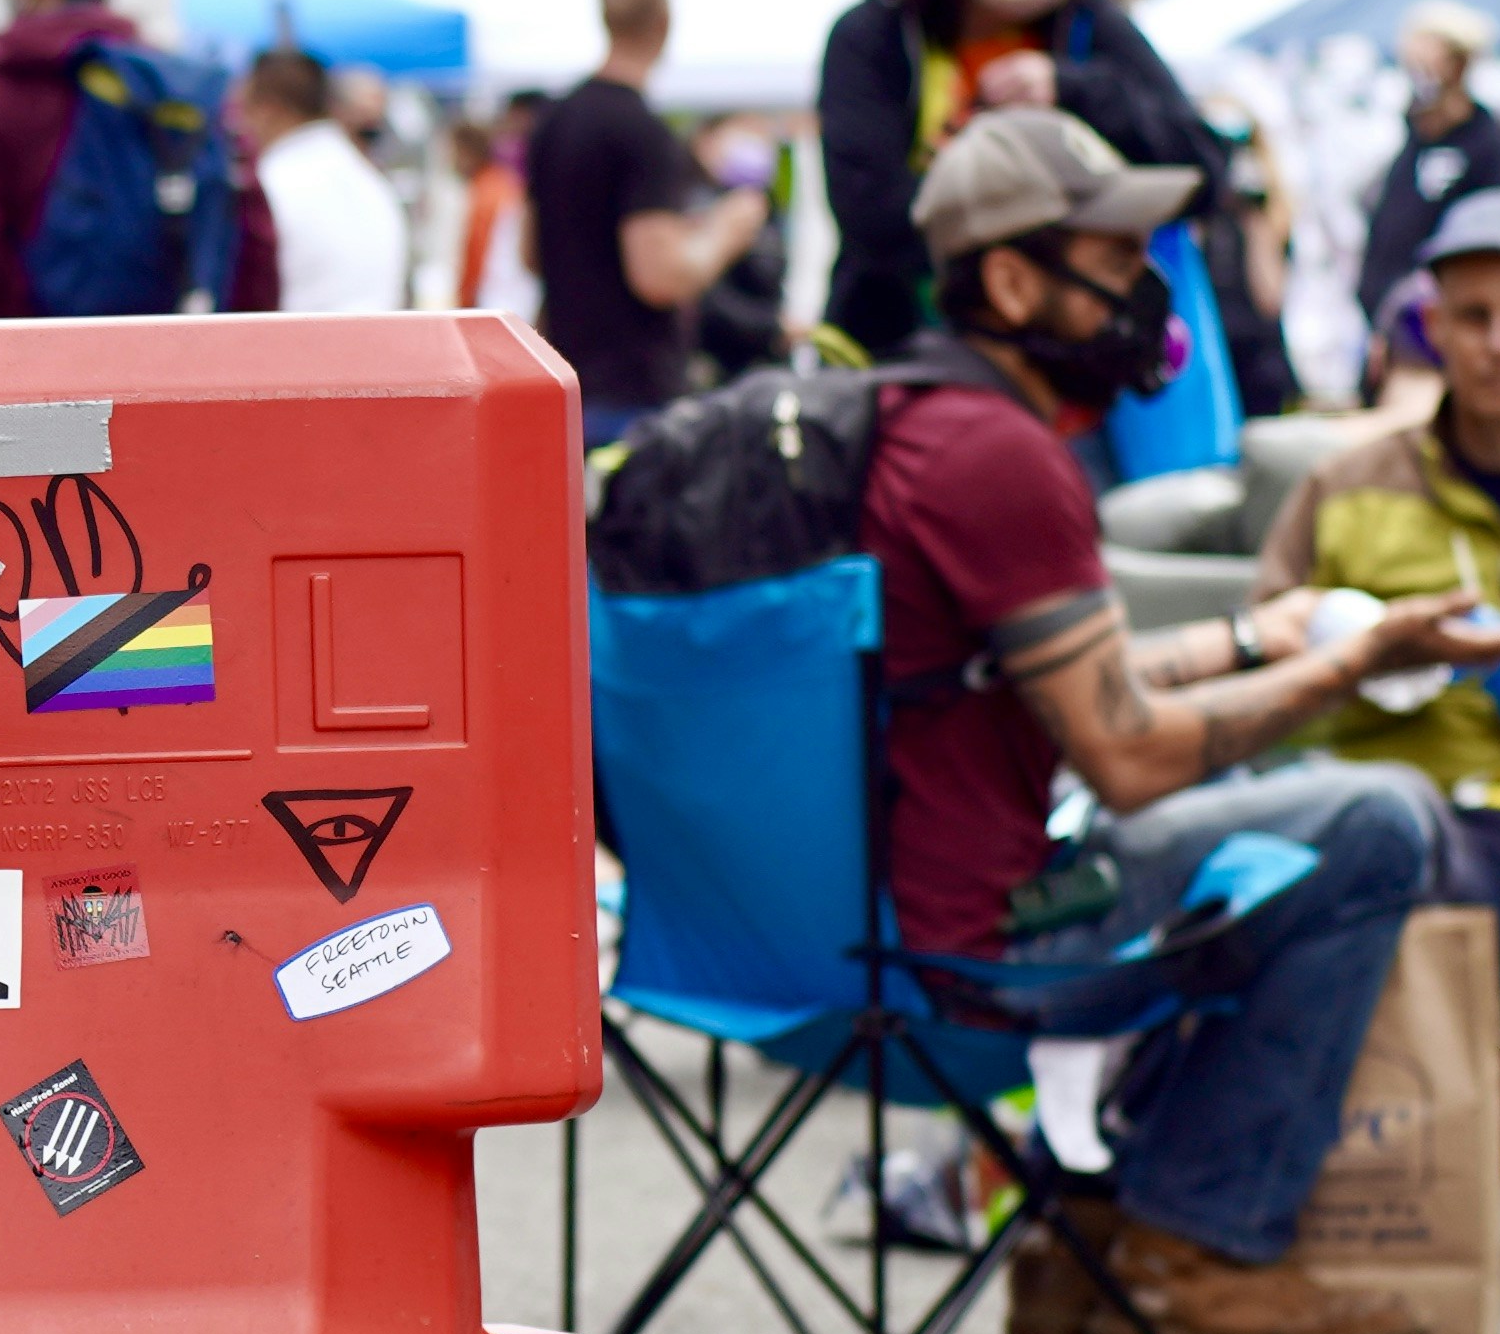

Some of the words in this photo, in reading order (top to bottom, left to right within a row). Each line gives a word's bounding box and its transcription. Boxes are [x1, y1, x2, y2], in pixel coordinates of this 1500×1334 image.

[71, 776, 111, 803] JSS
[0, 823, 126, 852] NCHRP-350
[167, 819, 251, 849] WZ-277
[304, 910, 429, 976] FREETOWN
[320, 940, 413, 994] SEATTLE
[10, 1088, 53, 1118] Hate-Free
[51, 1072, 79, 1093] Zone!
